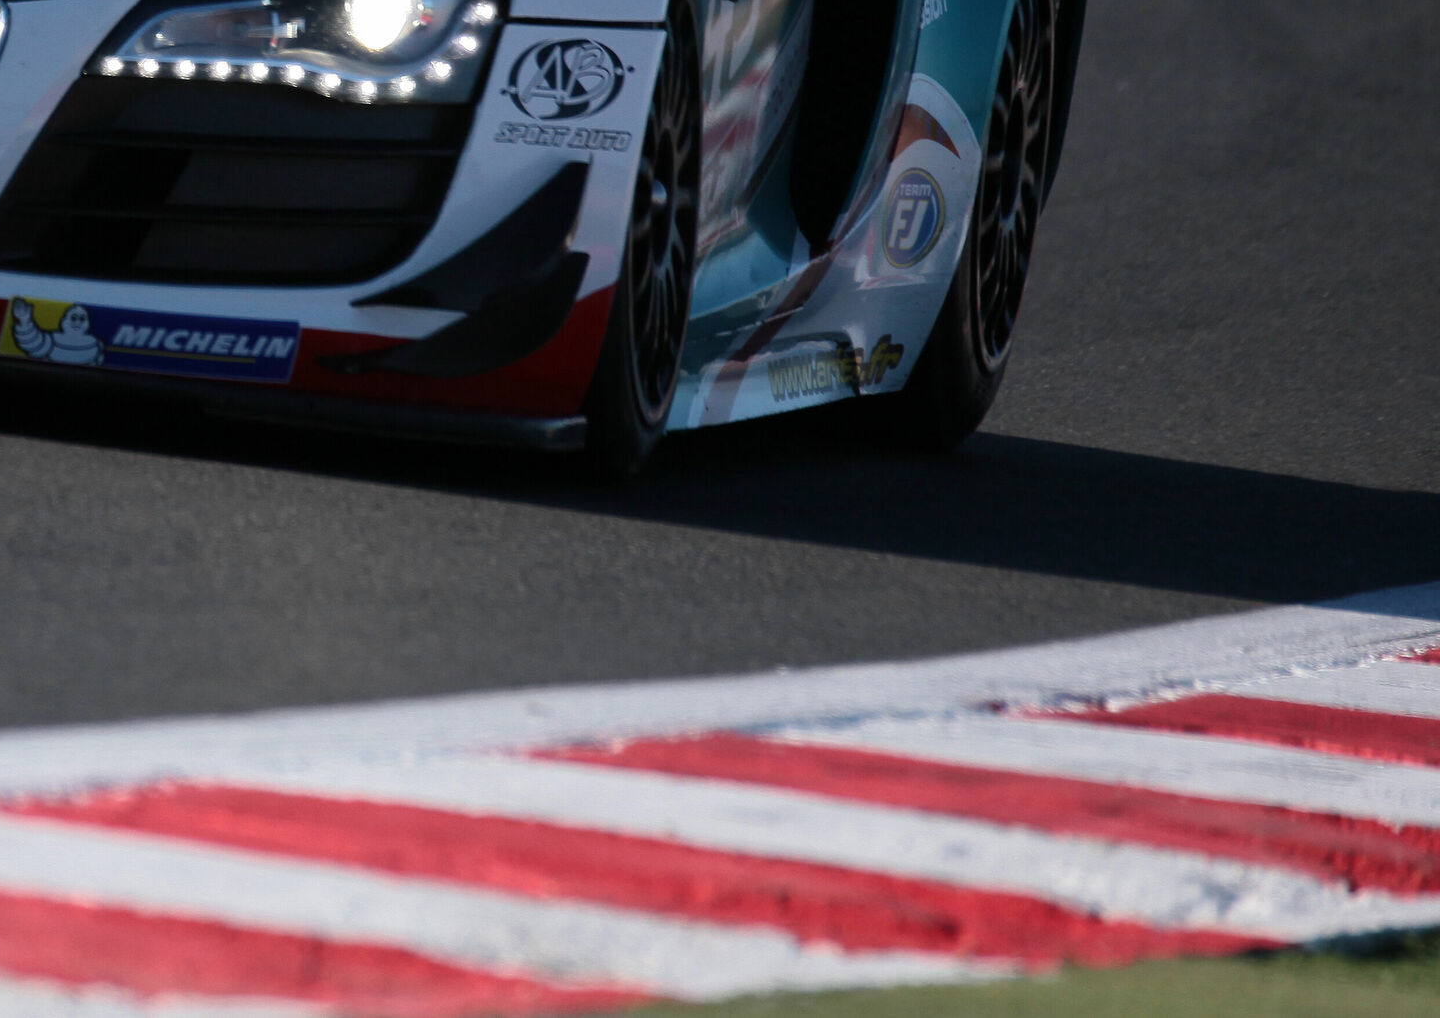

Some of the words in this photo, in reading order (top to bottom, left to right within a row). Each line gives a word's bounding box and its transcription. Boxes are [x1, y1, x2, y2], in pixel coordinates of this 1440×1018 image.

[493, 121, 571, 147] SPORT
[567, 127, 633, 152] AUTO
[899, 183, 932, 197] TEAM
[888, 199, 929, 251] FJ
[111, 325, 295, 360] MICHELIN
